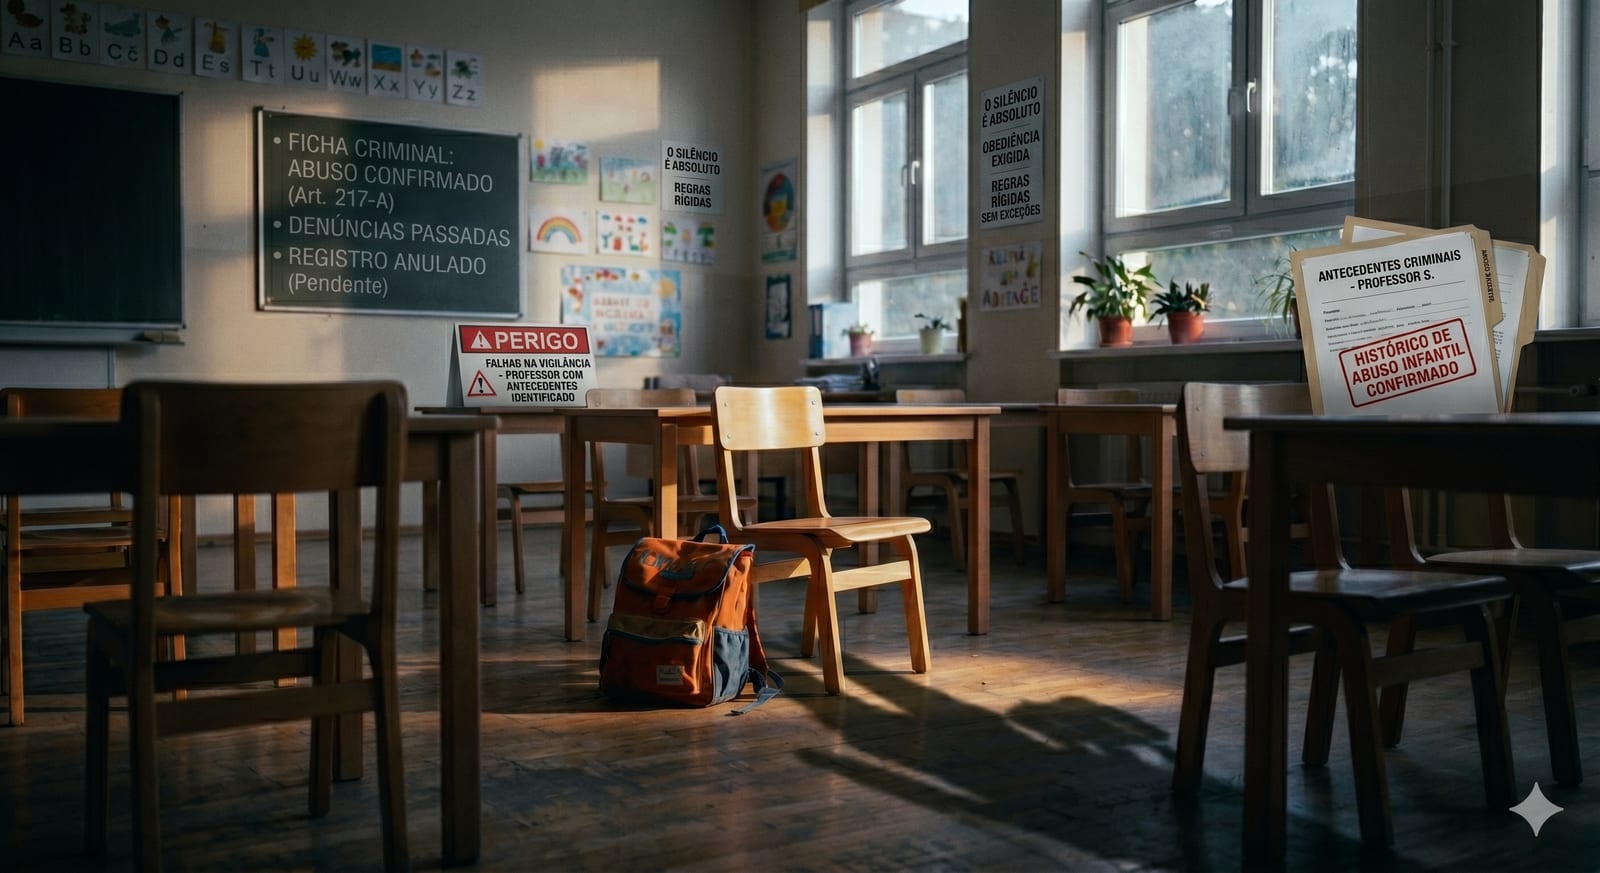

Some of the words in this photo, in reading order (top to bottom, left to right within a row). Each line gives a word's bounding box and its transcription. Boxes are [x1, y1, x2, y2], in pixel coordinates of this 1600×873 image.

[8, 32, 42, 51] Aa
[59, 37, 91, 56] Bb
[154, 50, 185, 68] Dd
[250, 59, 275, 78] Tt
[291, 65, 319, 83] Uu
[330, 69, 362, 88] Ww
[374, 75, 399, 92] Xx
[413, 79, 438, 99] Yy
[452, 84, 476, 101] Zz
[985, 98, 991, 112] O
[994, 86, 1037, 109] SILÊNCIO
[982, 113, 988, 128] É
[989, 101, 1040, 126] ABSOLUTO
[289, 132, 349, 156] FICHA
[355, 138, 454, 166] CRIMINAL:
[983, 129, 1040, 154] OBEDIÊNCIA
[667, 147, 673, 158] O
[676, 147, 718, 162] SILÊNCIO
[991, 148, 1030, 167] EXIGIDA
[288, 159, 358, 183] ABUSO
[364, 166, 493, 193] CONFIRMADO
[664, 158, 670, 169] É
[672, 162, 721, 175] ABSOLUTO
[674, 182, 711, 195] REGRAS
[991, 174, 1030, 192] REGRAS
[288, 185, 326, 208] (Art.
[335, 189, 394, 214] 217-A)
[674, 194, 712, 208] RÍGIDAS
[991, 190, 1030, 208] RÍGIDAS
[981, 211, 998, 223] SEM
[1000, 204, 1040, 220] EXCEÇÕES
[289, 214, 405, 241] DENÚNCIAS
[411, 223, 511, 247] PASSADAS
[289, 247, 388, 270] REGISTRO
[394, 252, 487, 275] ANULADO
[1318, 259, 1402, 283] ANTECEDENTES
[1404, 249, 1462, 268] CRIMINAIS
[288, 273, 388, 299] (Pendente)
[1358, 271, 1422, 291] PROFESSOR
[1424, 269, 1435, 281] S.
[494, 331, 579, 350] PERIGO
[1354, 333, 1430, 367] HISTÓRICO
[1432, 328, 1452, 343] DE
[486, 358, 522, 368] FALHAS
[524, 359, 537, 368] NA
[539, 357, 591, 368] VIGILÂNCIA
[1351, 362, 1399, 385] ABUSO
[1402, 342, 1466, 371] INFANTIL
[506, 370, 560, 380] PROFESSOR
[563, 370, 584, 379] COM
[1367, 361, 1460, 398] CONFIRMADO
[507, 381, 578, 391] ANTECEDENTES
[511, 392, 576, 402] IDENTIFICADO
